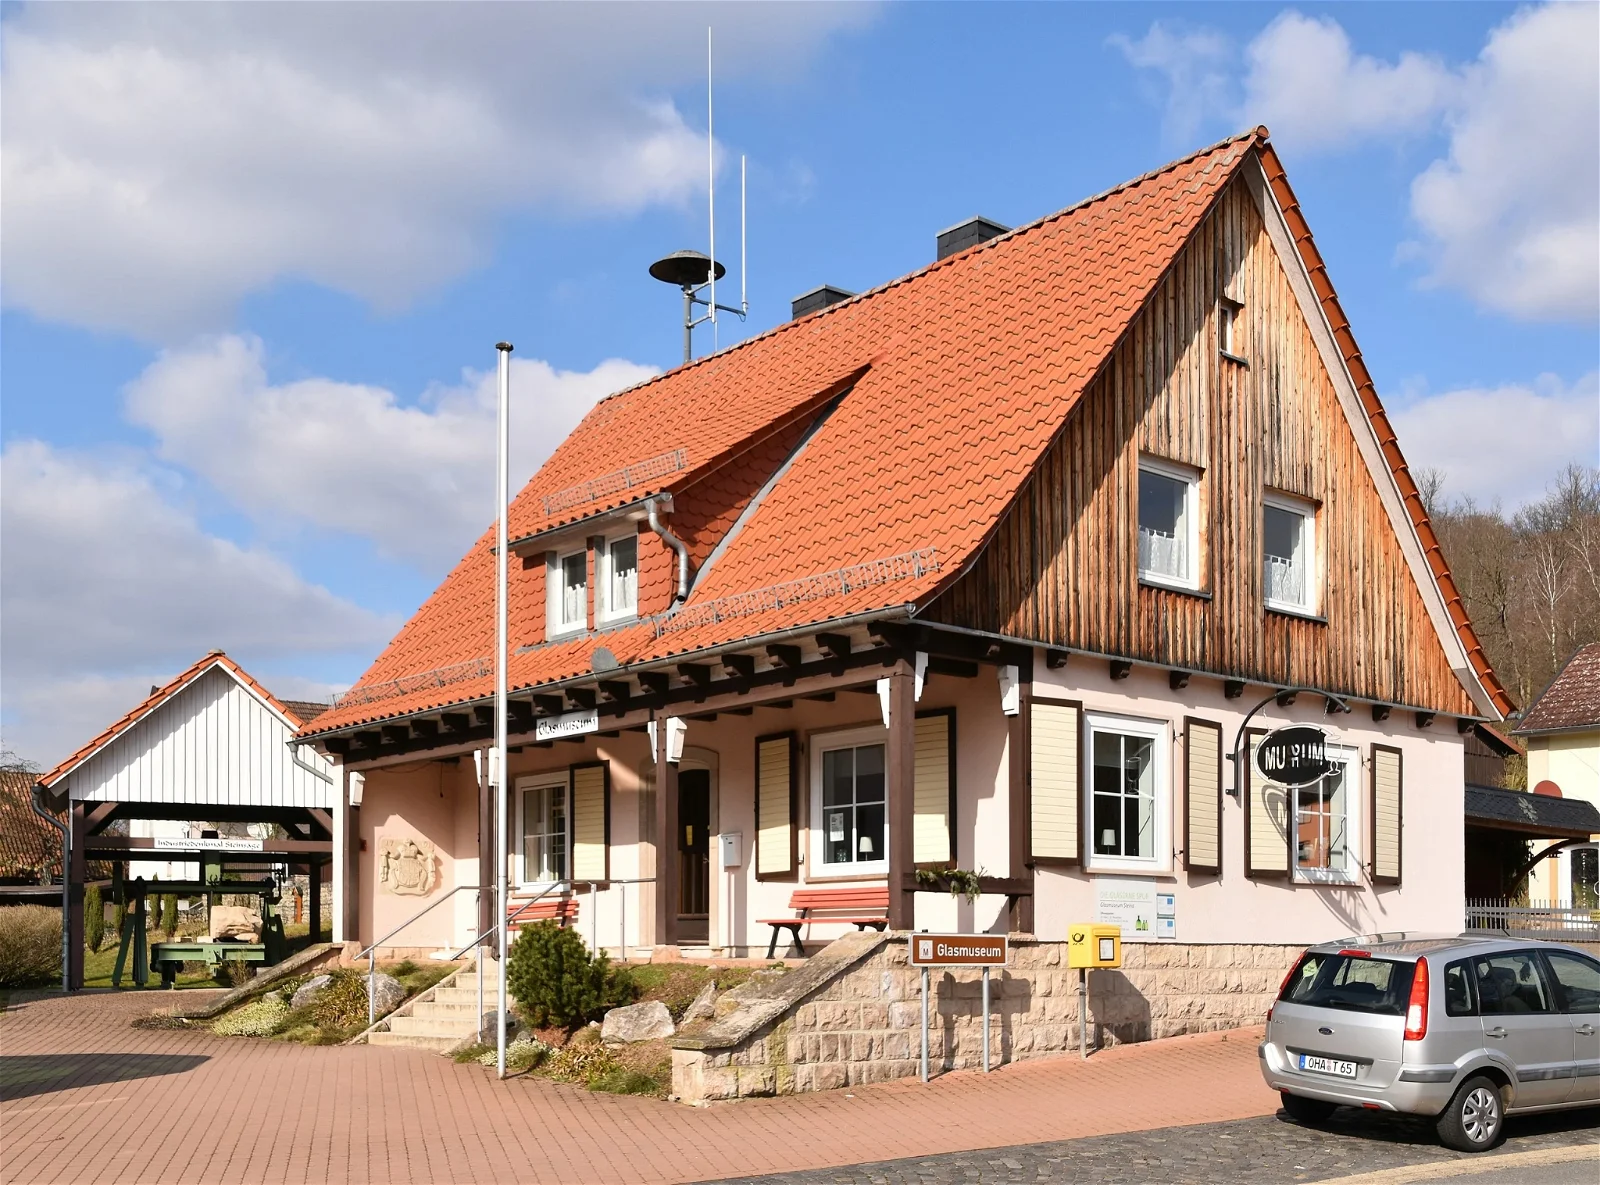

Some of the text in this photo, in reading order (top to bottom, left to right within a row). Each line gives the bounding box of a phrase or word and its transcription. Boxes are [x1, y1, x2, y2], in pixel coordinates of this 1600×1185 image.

[539, 719, 596, 735] Glasmuseum
[158, 839, 223, 848] Industriedenkmal
[937, 943, 1001, 957] Glasmuseum
[1308, 1057, 1352, 1074] OHA T 65
